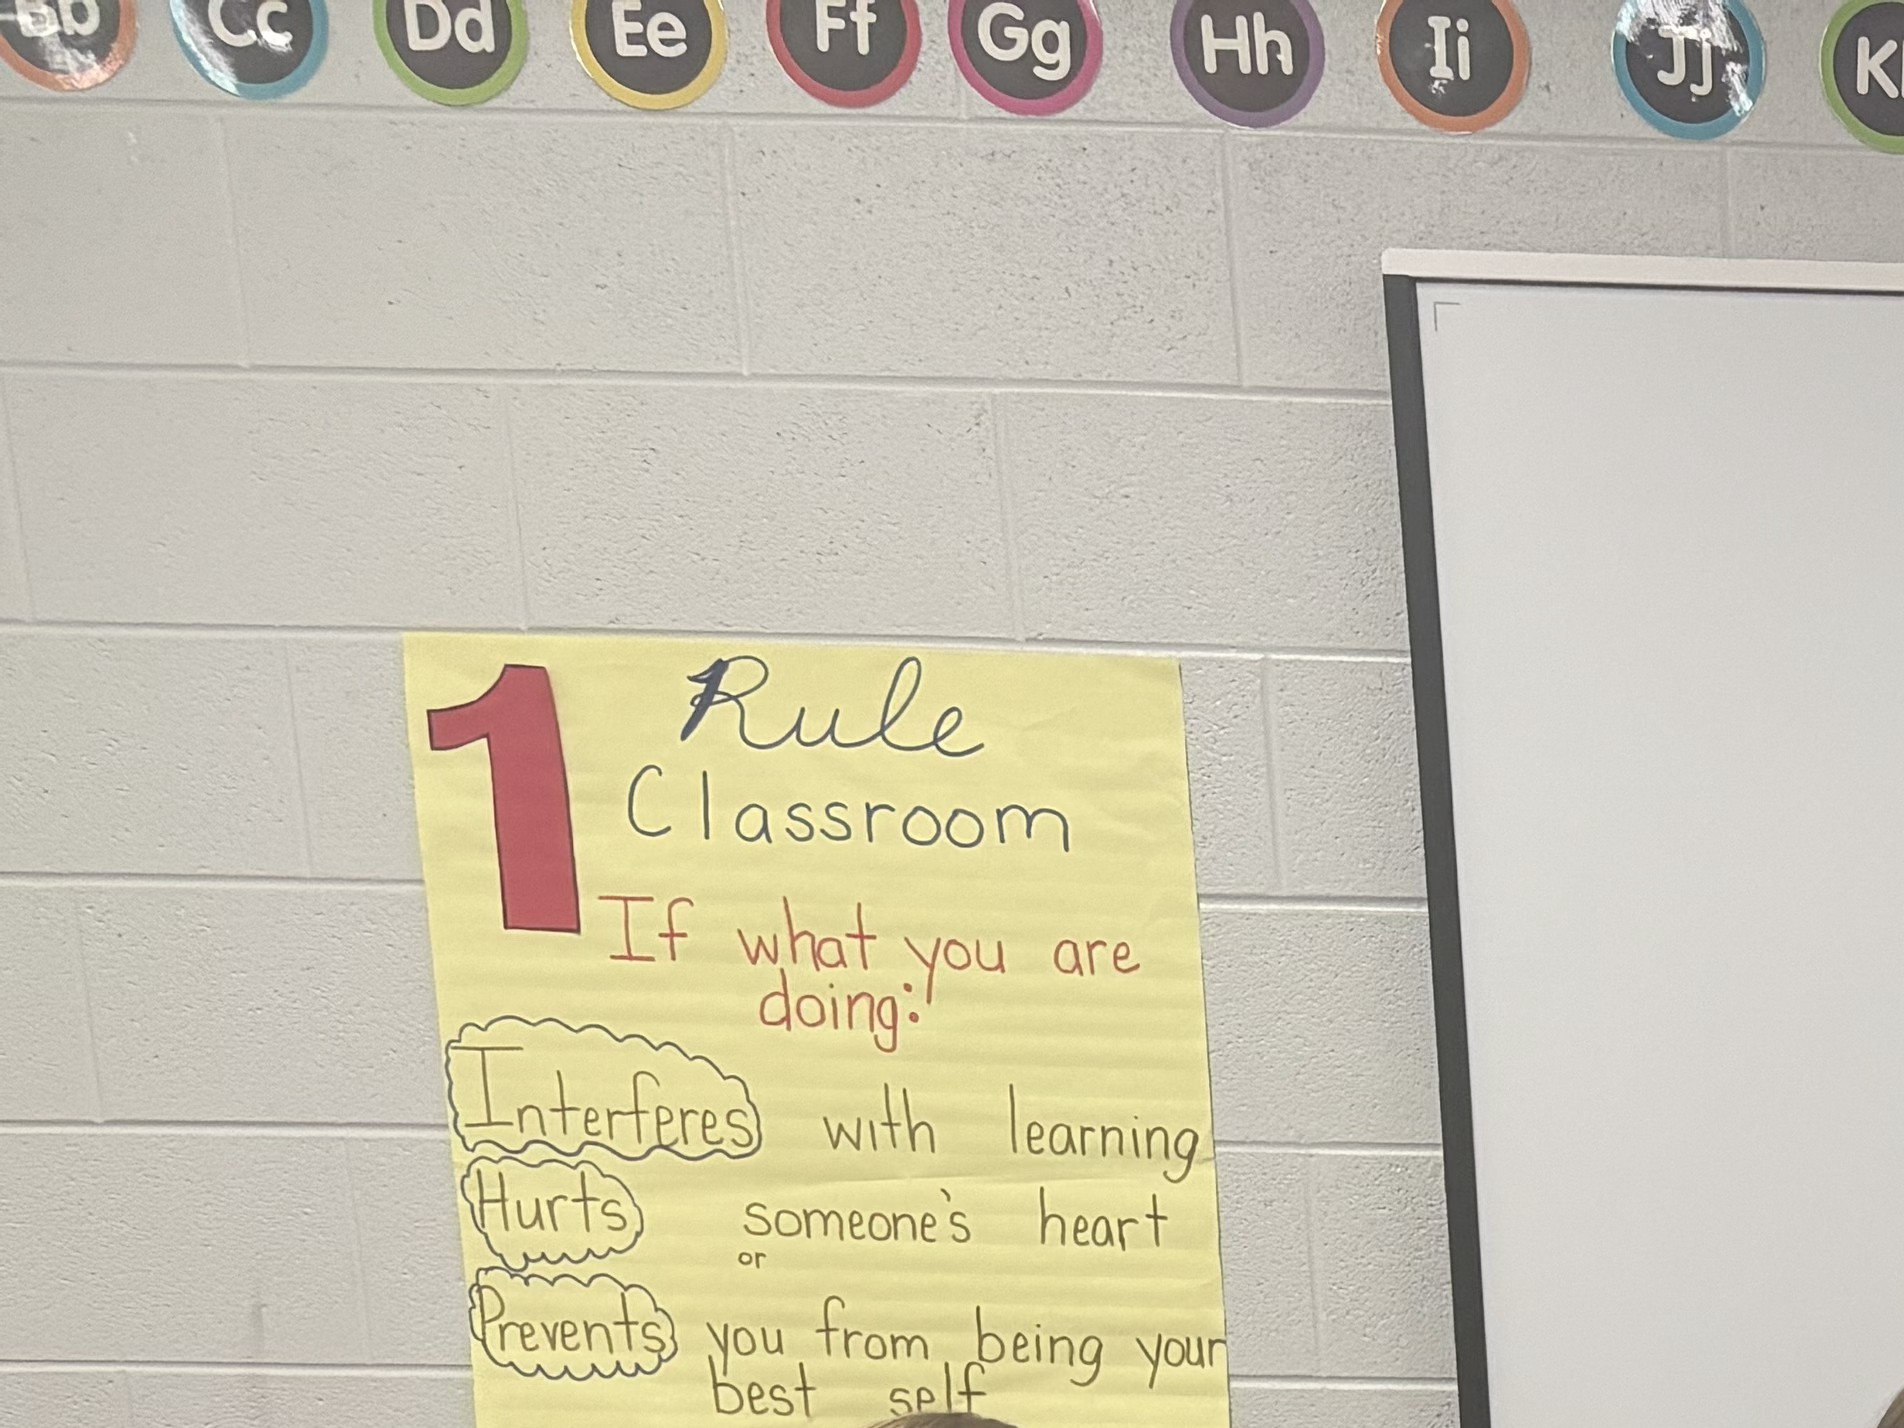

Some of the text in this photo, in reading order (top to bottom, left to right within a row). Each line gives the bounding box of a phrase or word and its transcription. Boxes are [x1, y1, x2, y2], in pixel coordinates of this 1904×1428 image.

[404, 0, 496, 54] Dd
[613, 0, 687, 58] Ee
[812, 0, 878, 55] Ff
[976, 0, 1072, 80] Gg
[1201, 13, 1292, 77] Hh
[1427, 16, 1470, 81] Ii
[1655, 28, 1713, 95] Jj
[681, 655, 985, 757] Rule
[428, 663, 581, 934] 1
[628, 765, 1071, 852] Classroom
[598, 895, 1141, 1004] If what you are
[759, 970, 921, 1053] doing:
[452, 1046, 1201, 1181] Interferes with learning
[477, 1170, 1168, 1248] Hurts someone's heart
[738, 1250, 766, 1270] or
[480, 1283, 1225, 1388] Prevents you from being your
[709, 1357, 986, 1416] best self
